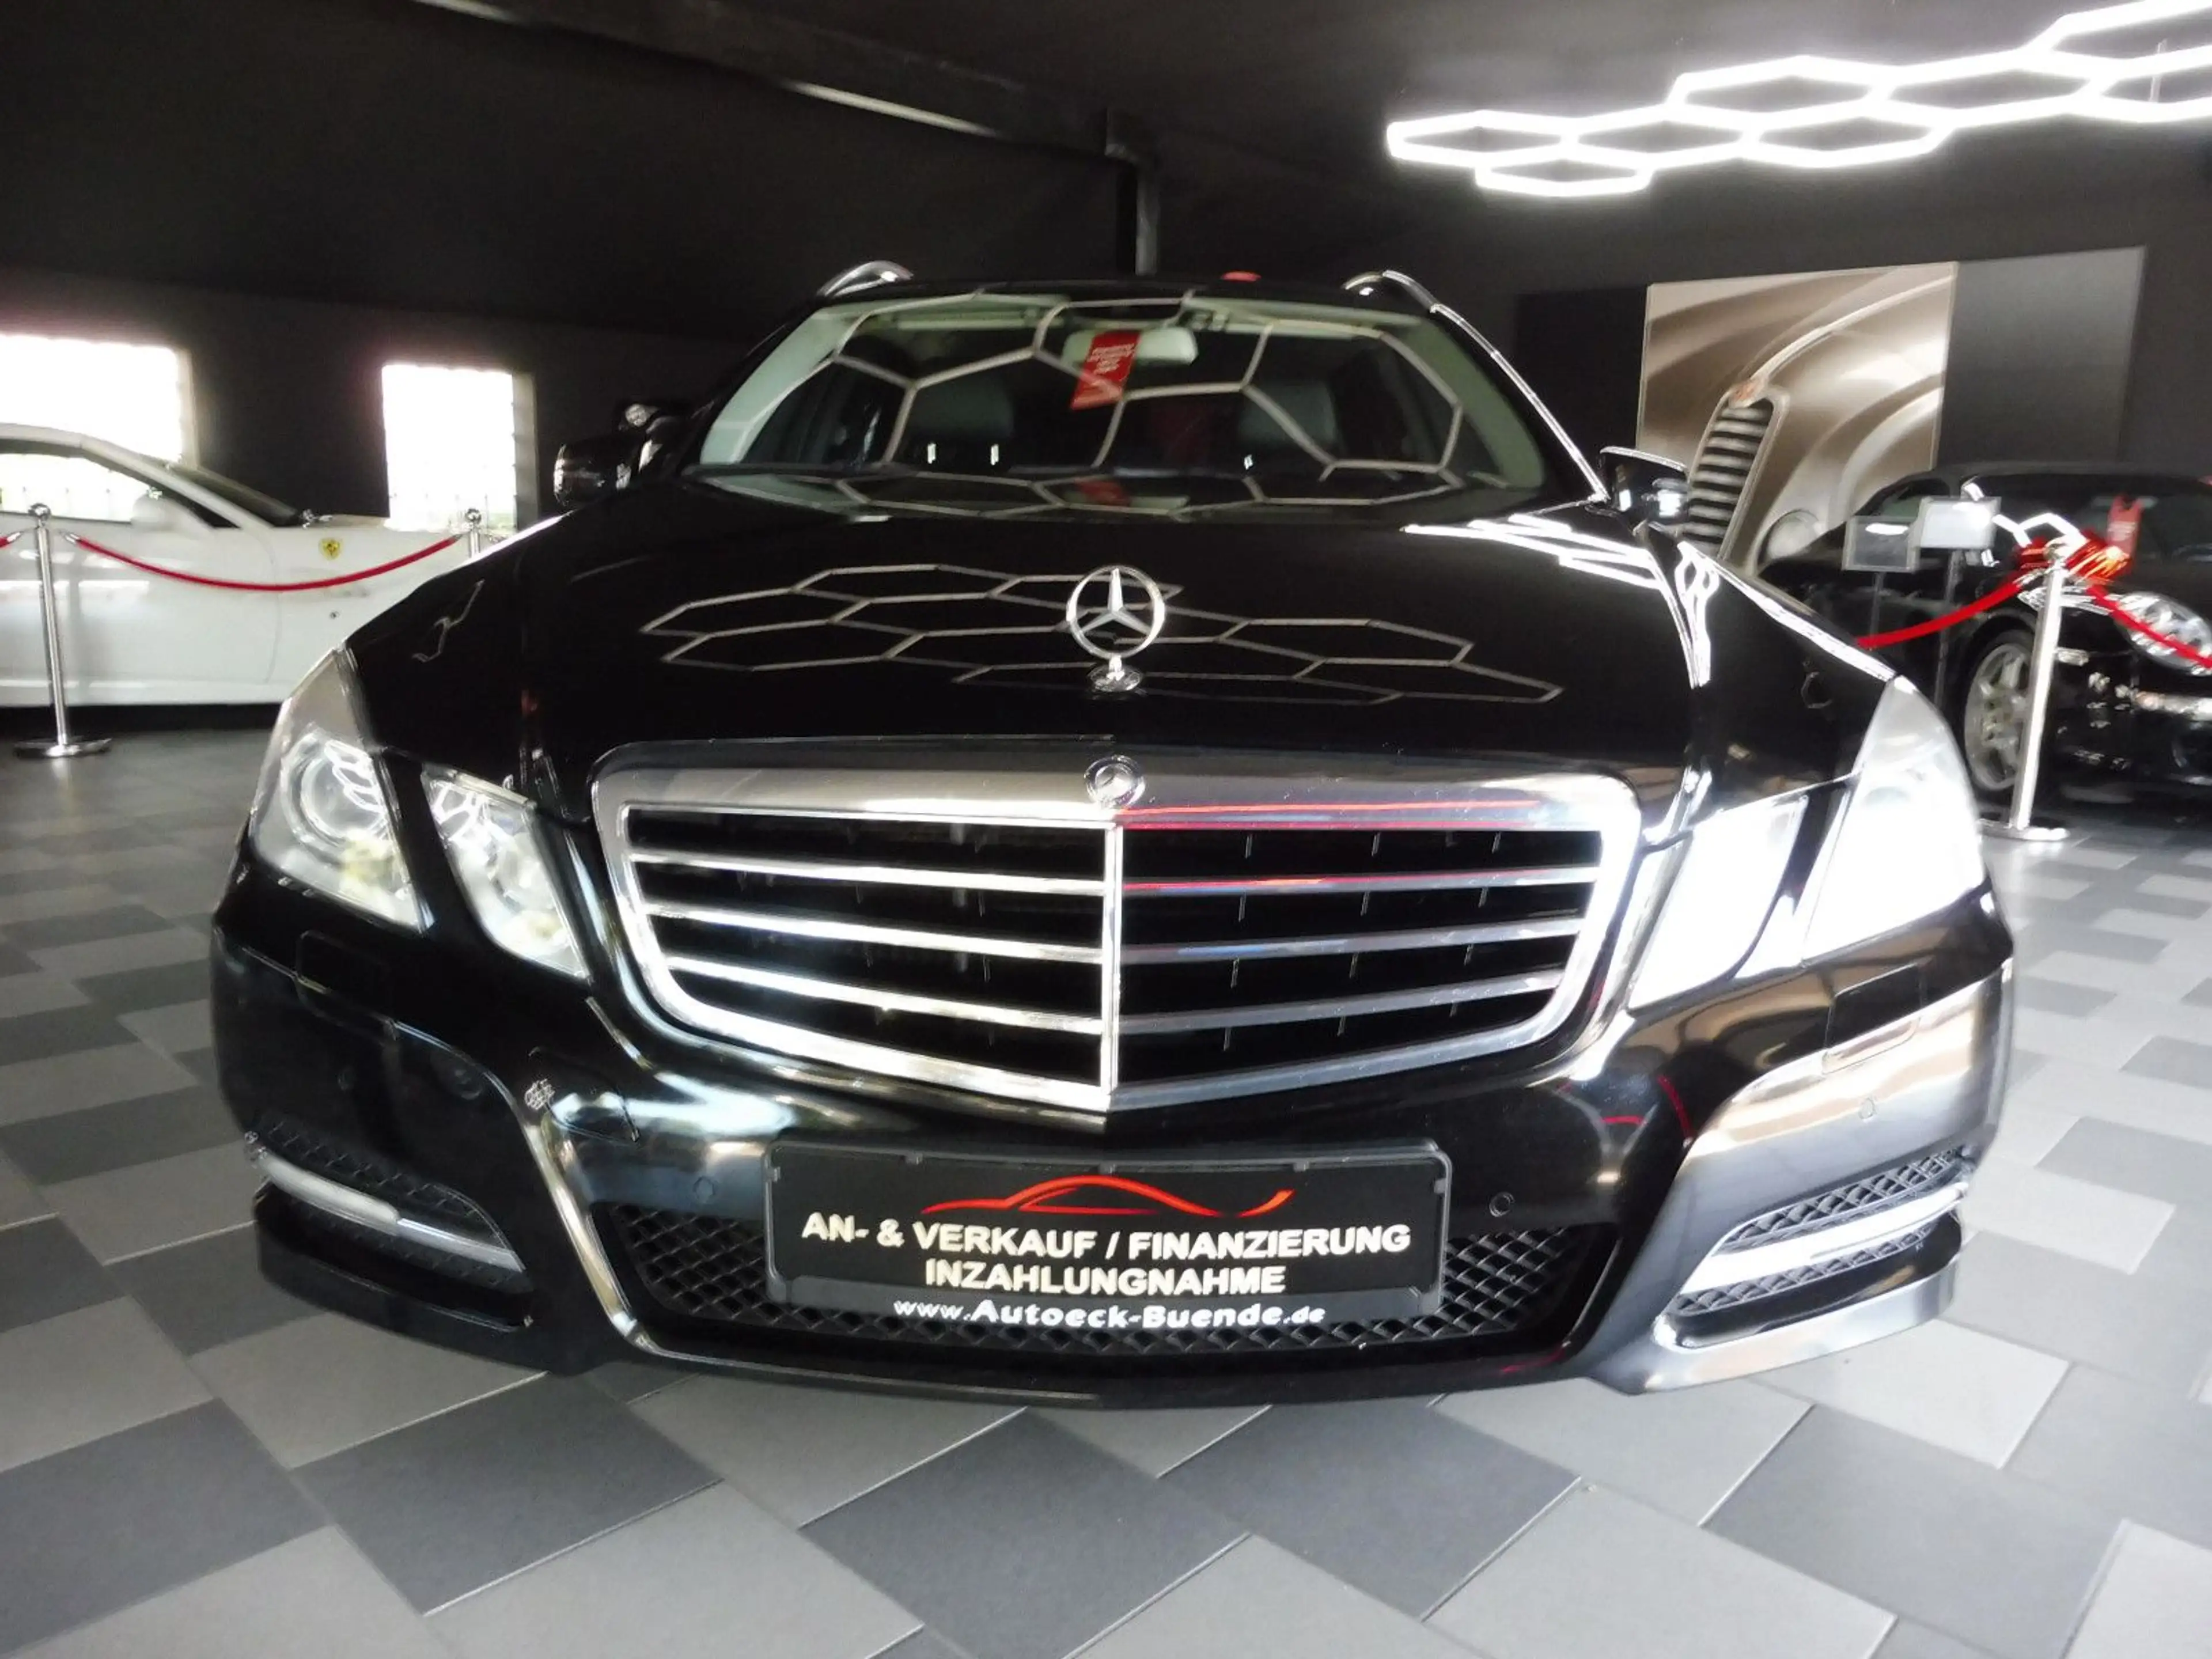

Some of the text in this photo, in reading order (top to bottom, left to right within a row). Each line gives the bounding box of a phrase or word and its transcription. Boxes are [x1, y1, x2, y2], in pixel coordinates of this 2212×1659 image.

[801, 1213, 1412, 1260] AN- & VERKAUF / FINANZIERUNG
[925, 1259, 1286, 1296] INZAHLUNGNAHME
[894, 1298, 1326, 1328] www.Autoeck-Buende.de
